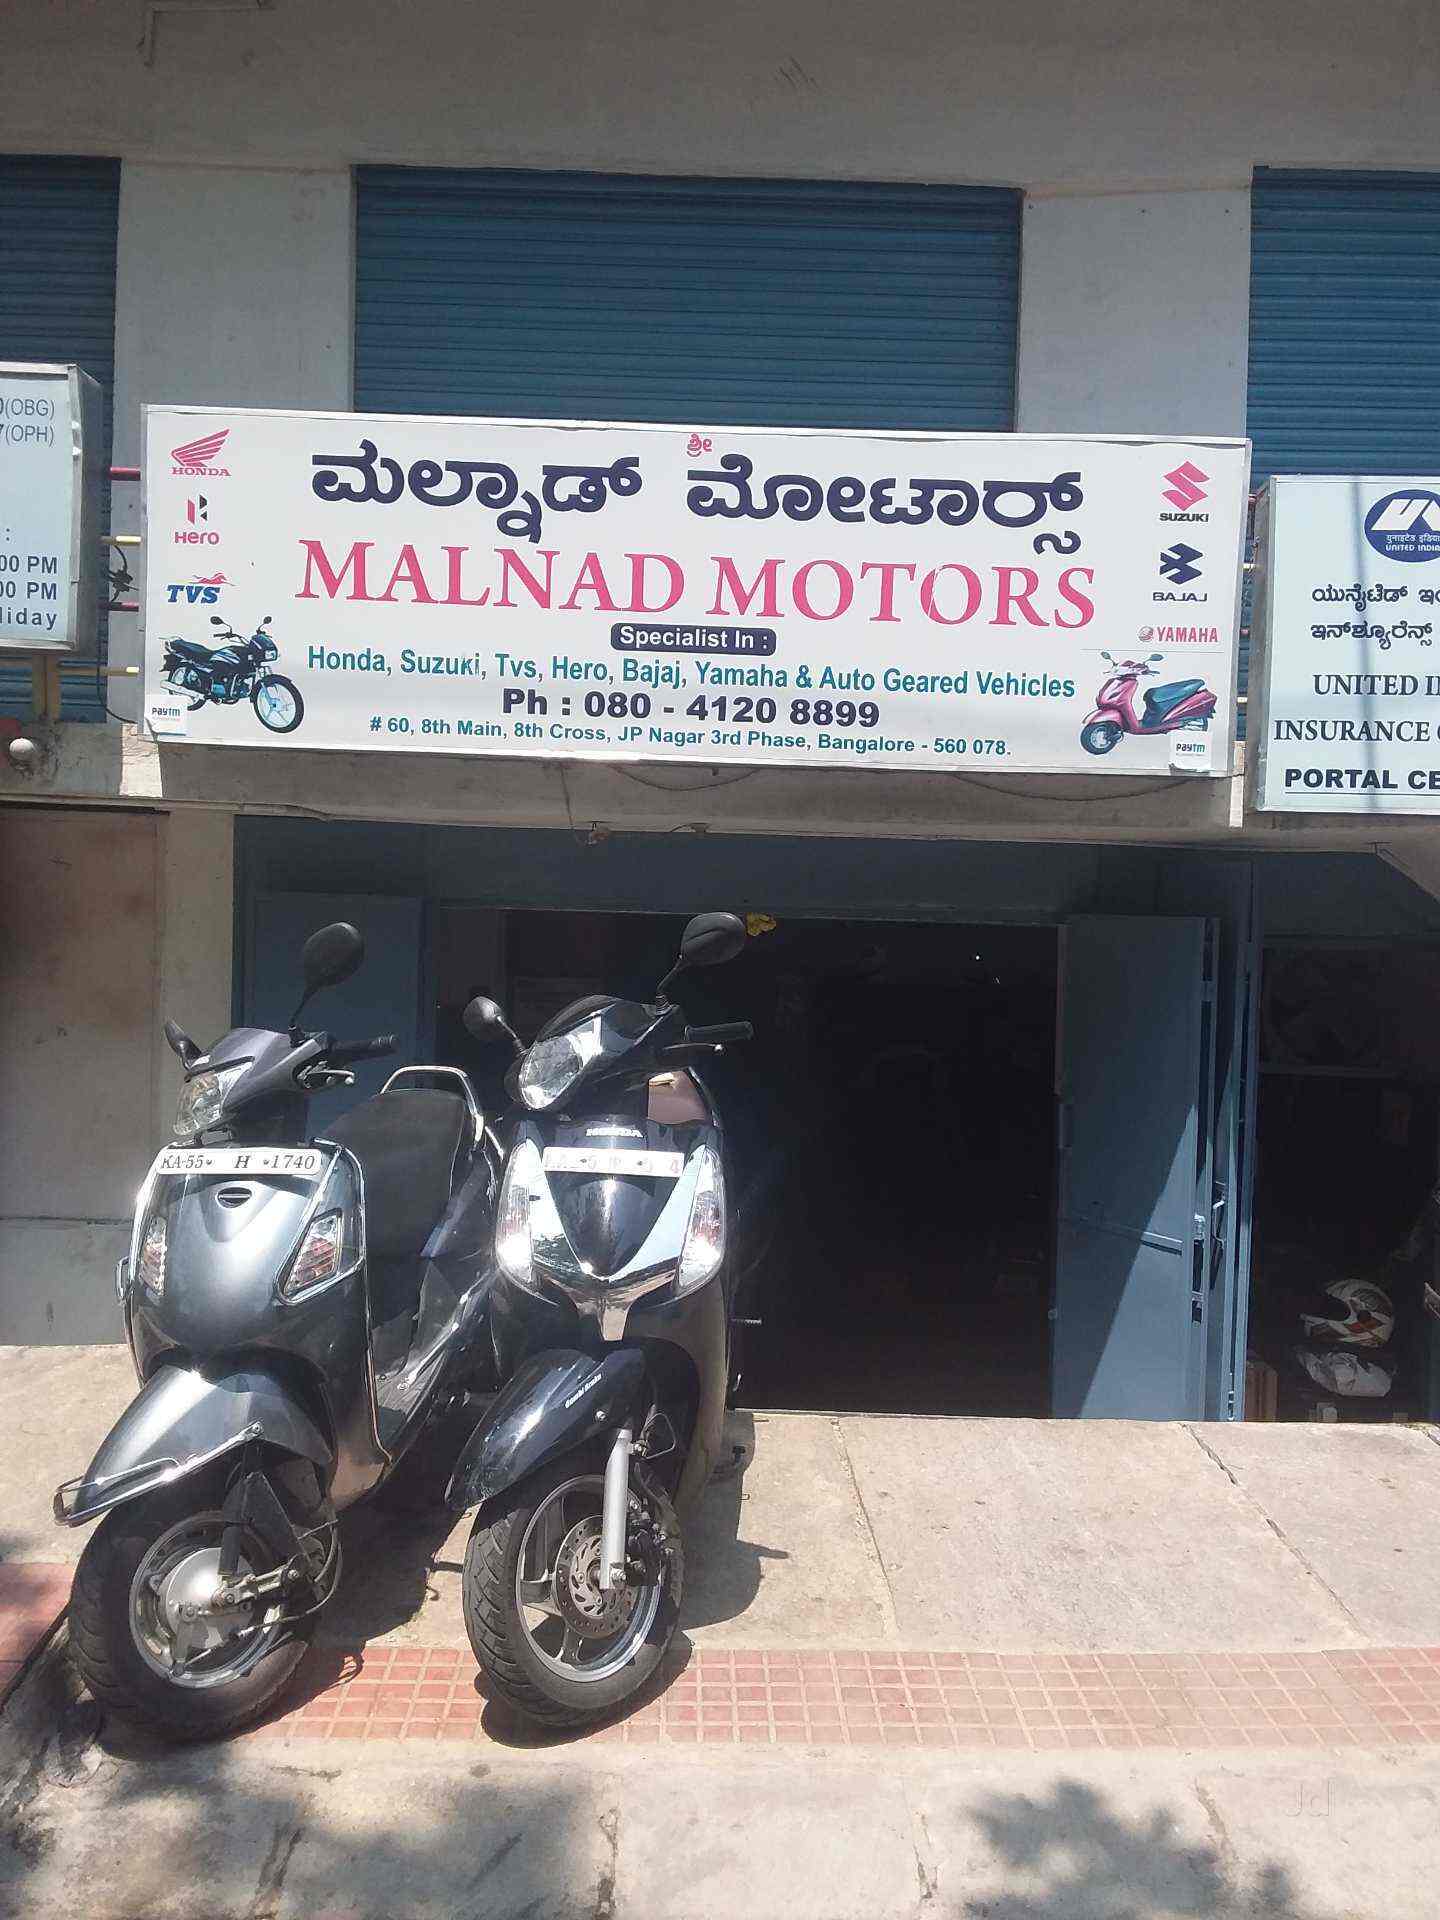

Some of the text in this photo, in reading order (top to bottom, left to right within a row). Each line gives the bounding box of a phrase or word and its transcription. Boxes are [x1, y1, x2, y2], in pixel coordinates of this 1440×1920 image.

[171, 467, 231, 476] HONDA
[1159, 513, 1209, 522] SUZUKI
[174, 531, 219, 545] Hero
[1385, 544, 1415, 552] UNITED
[28, 556, 57, 574] PM
[27, 582, 57, 600] PM
[295, 539, 1095, 628] MALNAD MOTORS
[167, 585, 220, 603] TVS
[1152, 592, 1207, 602] BAJAJ
[620, 625, 728, 649] Specialist
[735, 630, 754, 648] In
[1157, 627, 1219, 643] YAMAHA
[308, 646, 1075, 697] Honda, Suzuki, Tvs, Hero, Bajaj, Yamaha & Auto Geared Vehicles
[1313, 674, 1418, 696] UNITED
[503, 688, 548, 715] Ph
[584, 690, 651, 719] 080
[686, 694, 777, 724] 4120
[790, 699, 880, 728] 8899
[370, 716, 382, 732] #
[388, 717, 414, 736] 60,
[421, 719, 450, 735] 8th
[457, 720, 508, 740] Main,
[514, 722, 543, 738] 8th
[550, 723, 611, 743] Cross,
[618, 726, 643, 741] JP
[650, 727, 706, 747] Nagar
[711, 729, 741, 745] 3rd
[748, 731, 811, 750] Phase,
[818, 733, 915, 754] Bangalore
[934, 737, 967, 753] 560
[973, 740, 1011, 755] 078.
[1274, 720, 1430, 742] INSURANCE
[1285, 768, 1398, 789] PORTAL
[271, 1155, 315, 1169] 1740
